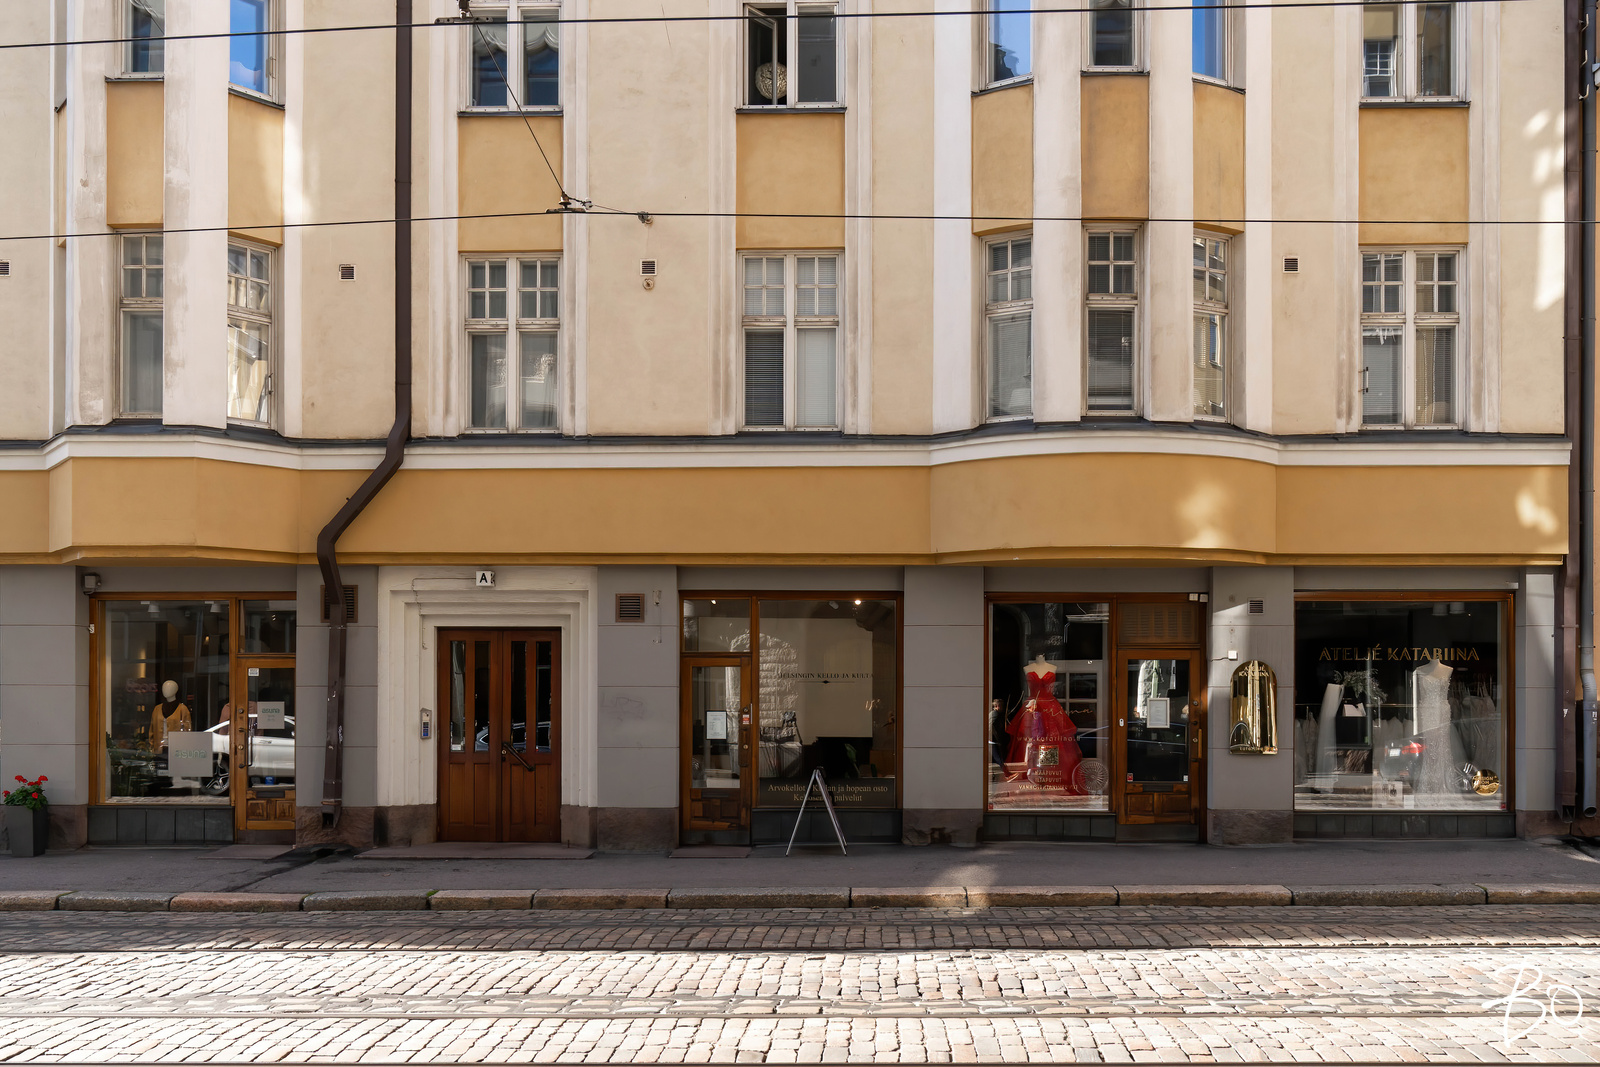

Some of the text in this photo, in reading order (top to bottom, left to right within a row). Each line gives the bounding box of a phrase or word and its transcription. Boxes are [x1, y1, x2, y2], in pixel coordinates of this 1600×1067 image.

[480, 573, 488, 583] A
[1319, 643, 1480, 661] ATELJÉ KATARIINA
[175, 750, 207, 759] asuna
[767, 784, 805, 792] Arvokellot
[812, 784, 836, 792] Klan
[837, 784, 845, 793] ja
[846, 784, 872, 793] hopean
[834, 794, 862, 802] palvelut
